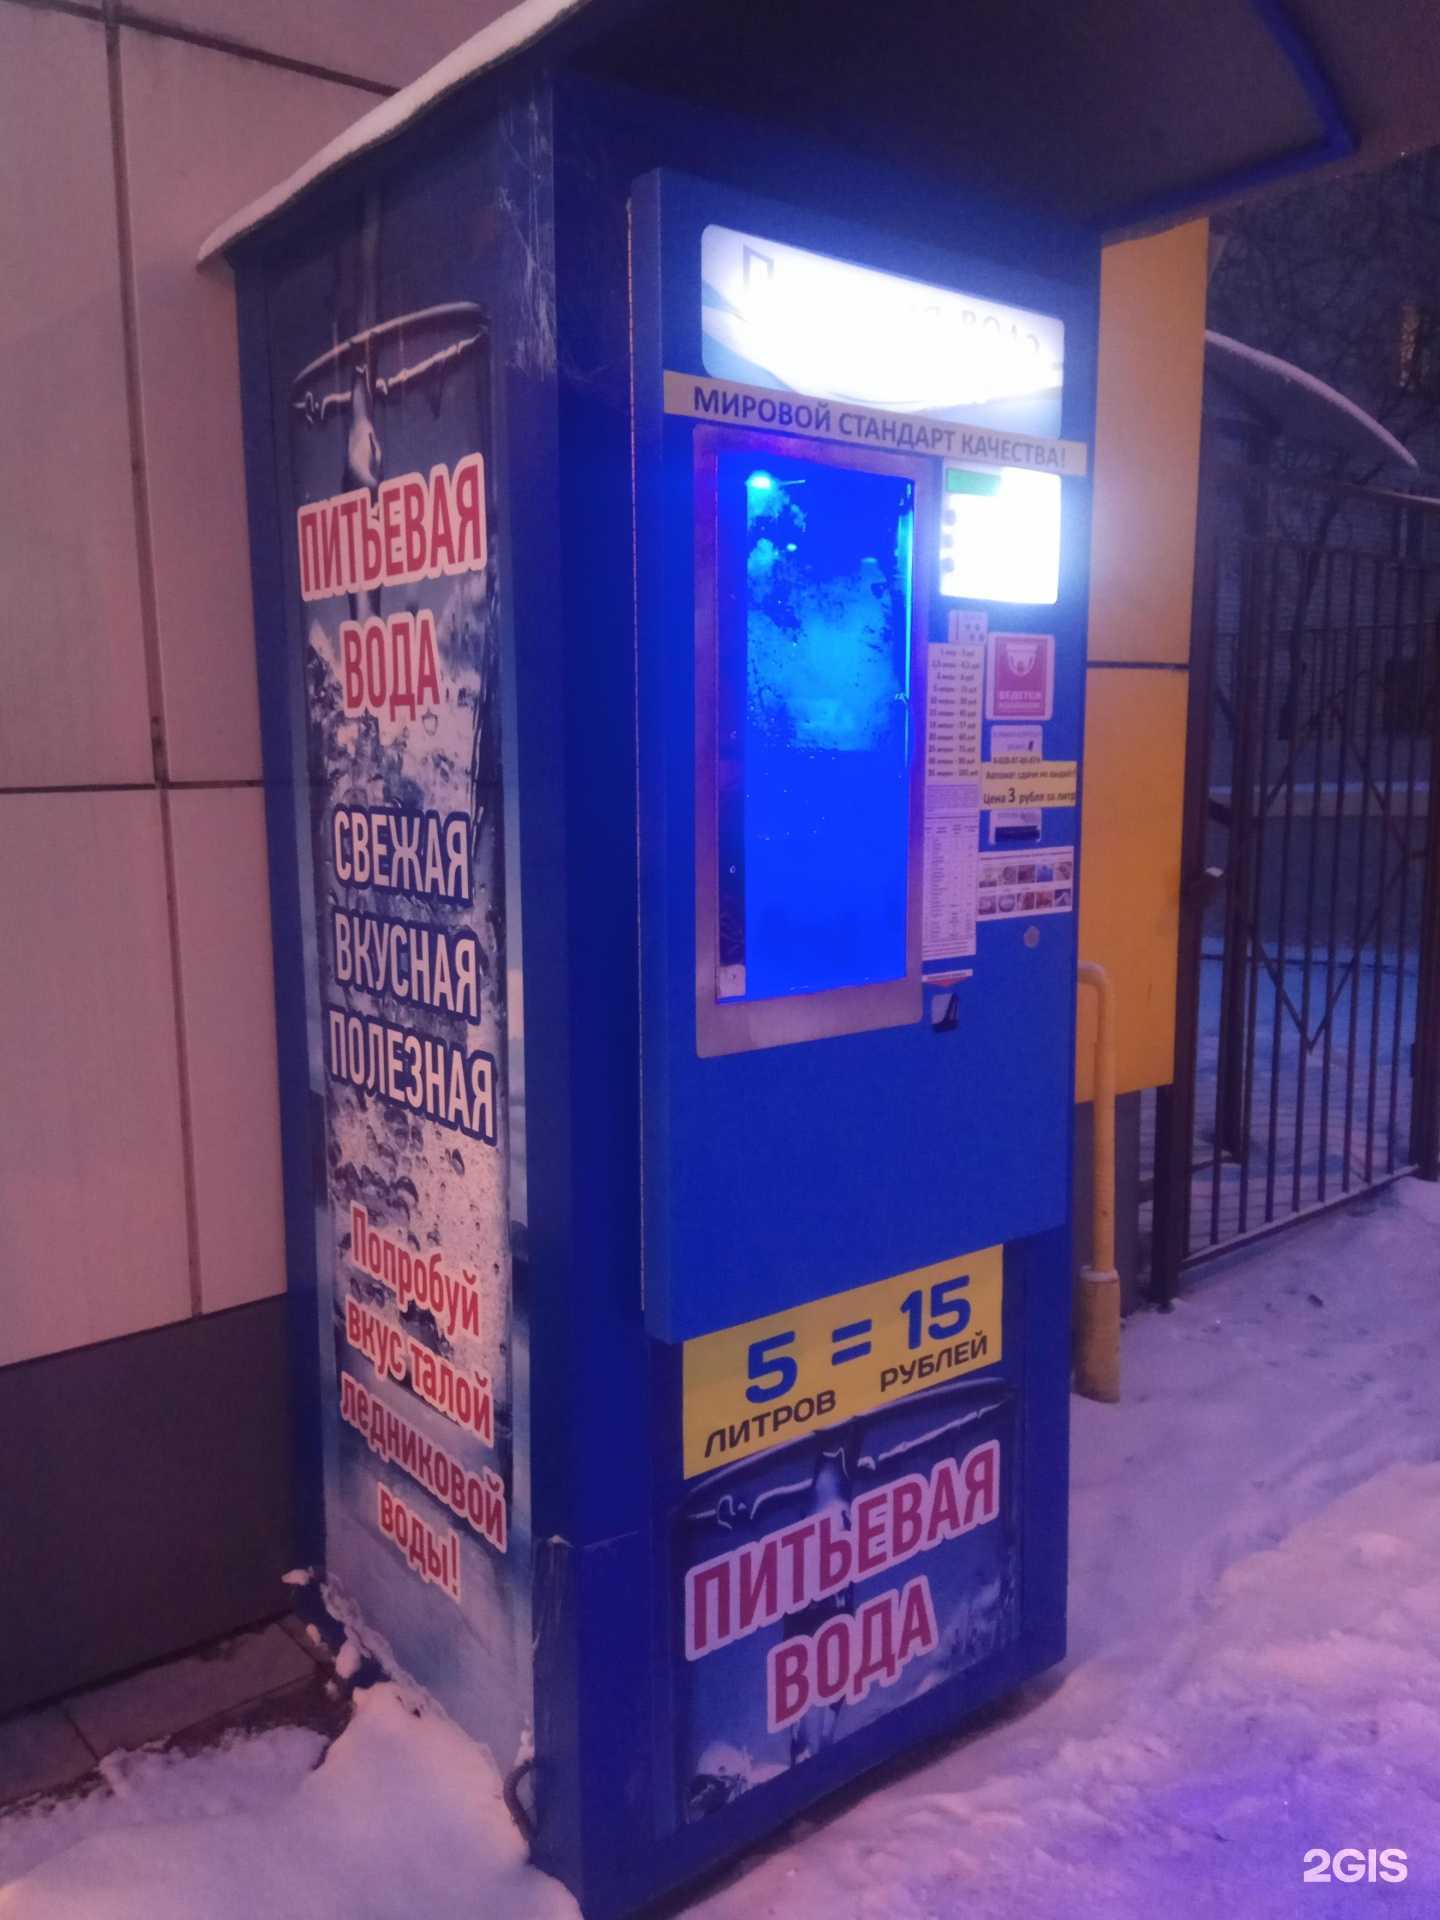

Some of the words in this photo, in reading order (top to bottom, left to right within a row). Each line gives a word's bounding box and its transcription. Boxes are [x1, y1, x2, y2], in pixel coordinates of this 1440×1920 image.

[693, 385, 831, 433] МИРОВОЙ
[838, 412, 956, 451] СТАНДАРТ
[961, 430, 1067, 467] КАЧЕСТВА!
[299, 463, 482, 594] ПИТЬЕВАЯ
[343, 618, 441, 722] ВОДА
[333, 809, 470, 900] СВЕЖАЯ
[1007, 786, 1016, 803] 3
[334, 912, 479, 1018] ВКУСНАЯ
[328, 1009, 495, 1138] ПОЛЕЗНАЯ
[351, 1206, 480, 1337] Попробуй
[346, 1299, 403, 1374] вкус
[410, 1341, 491, 1441] талой
[703, 1388, 837, 1459] ЛИТРОВ
[879, 1330, 988, 1394] РУБЛЕЙ
[745, 1329, 797, 1404] 5
[899, 1274, 972, 1351] 15
[341, 1377, 505, 1547] ледниковой
[378, 1487, 459, 1596] воды!
[692, 1446, 995, 1653] ПИТЬЕВАЯ
[774, 1580, 934, 1726] ВОДА
